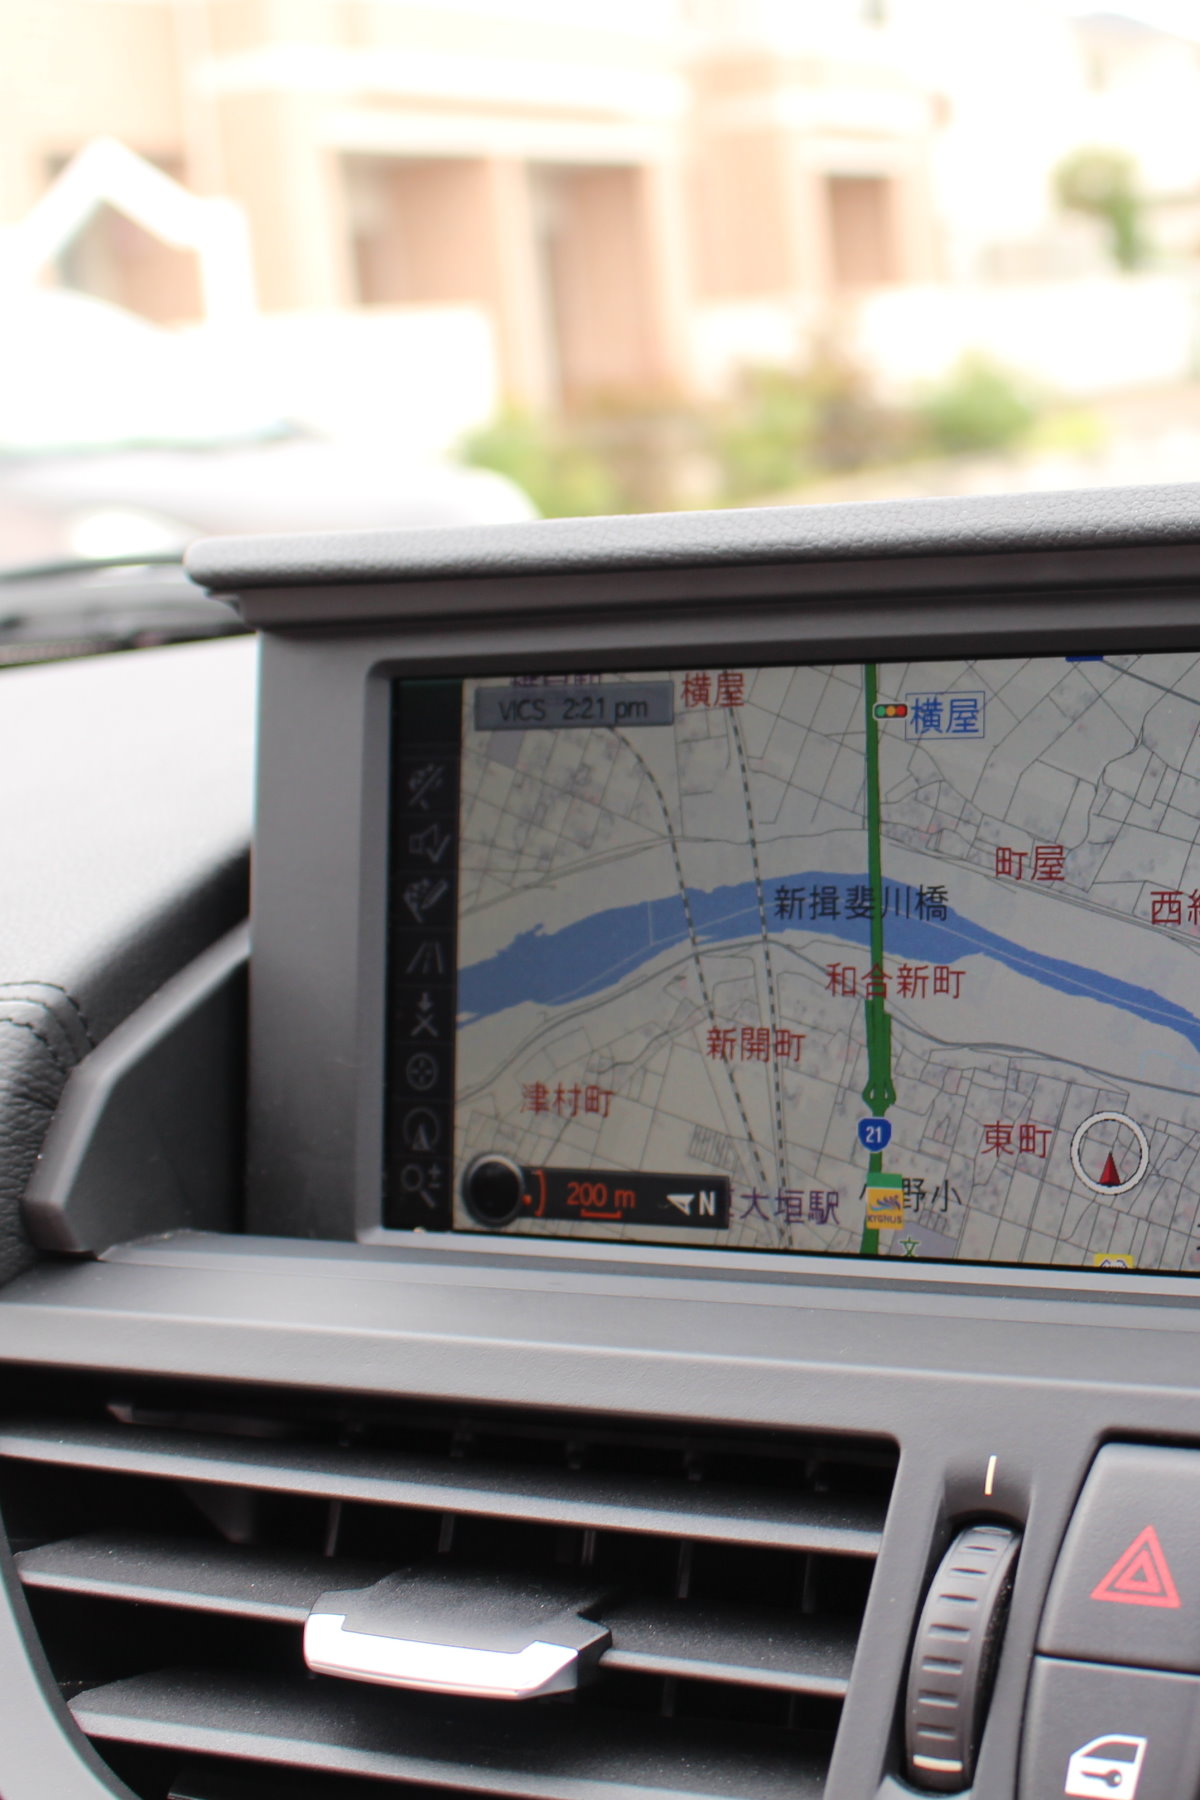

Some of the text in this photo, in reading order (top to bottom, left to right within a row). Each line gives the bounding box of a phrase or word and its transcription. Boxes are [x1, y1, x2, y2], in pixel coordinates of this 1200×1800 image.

[681, 671, 746, 708] 横屋
[499, 696, 649, 723] VICS 2:21 pm
[909, 696, 980, 735] 横屋
[995, 844, 1066, 881] 町屋
[773, 883, 949, 922] 新揖斐川橋
[824, 962, 967, 1000] 和合新町
[706, 1024, 807, 1063] 新開町
[519, 1080, 615, 1119] 津村町
[865, 1126, 882, 1143] 21
[981, 1119, 1053, 1159] 東町
[566, 1181, 636, 1209] 200 m
[699, 1190, 716, 1217] N
[728, 1186, 841, 1226] 大垣駅
[858, 1177, 962, 1214] 野小
